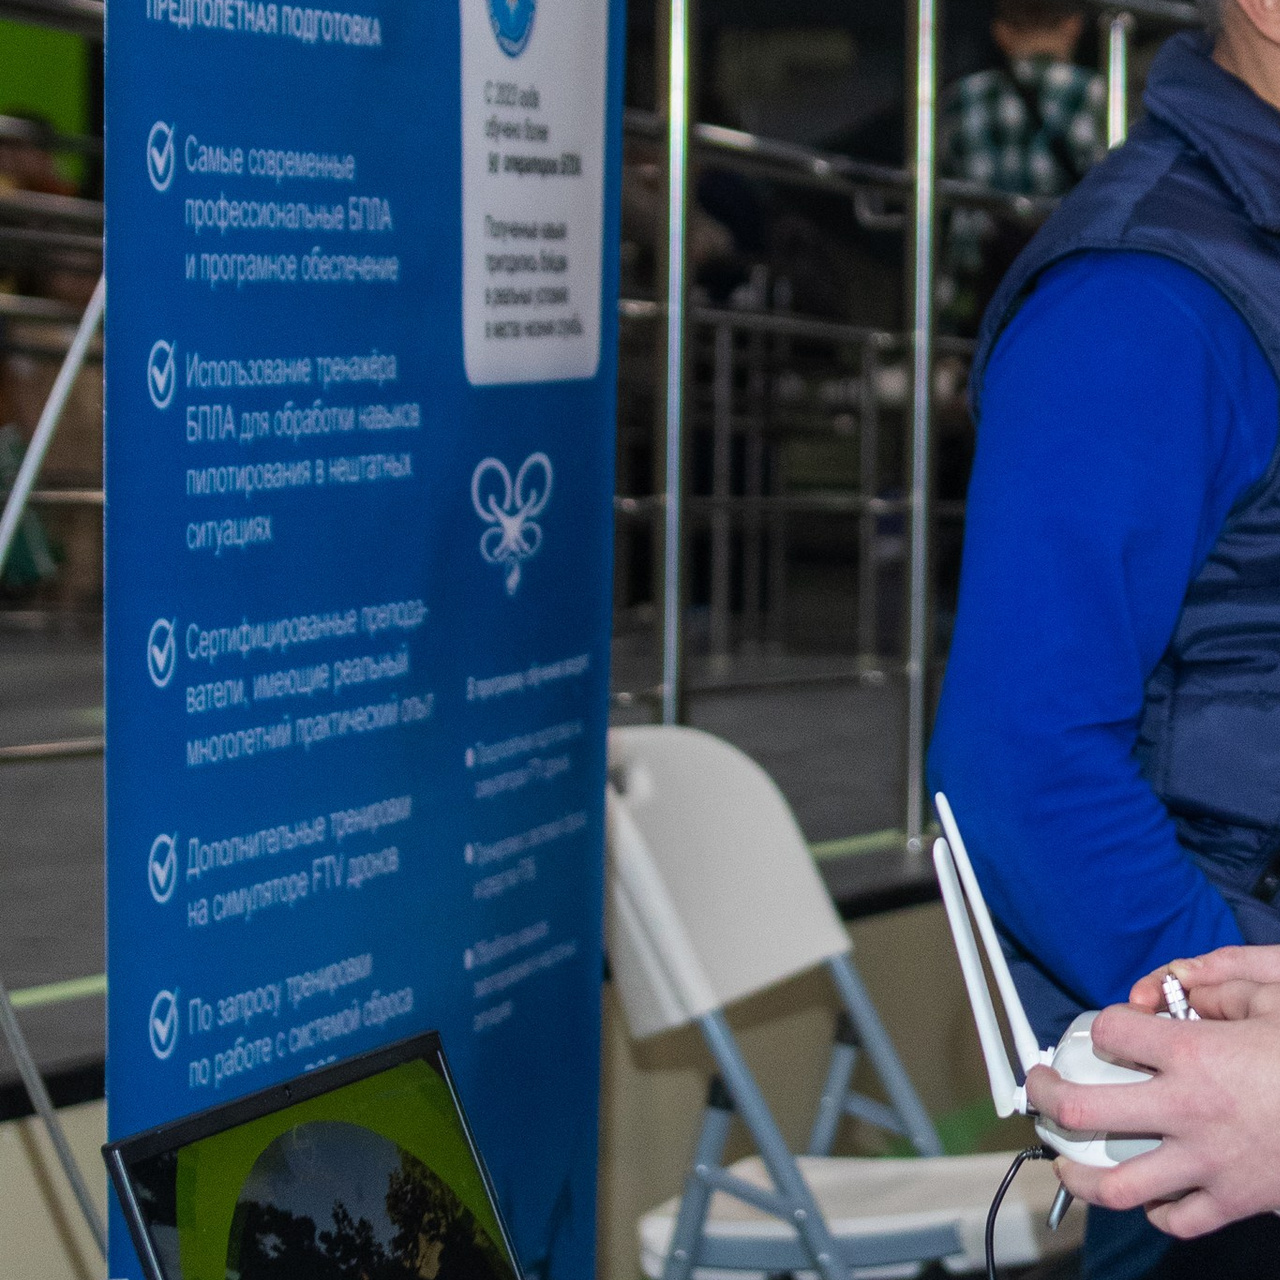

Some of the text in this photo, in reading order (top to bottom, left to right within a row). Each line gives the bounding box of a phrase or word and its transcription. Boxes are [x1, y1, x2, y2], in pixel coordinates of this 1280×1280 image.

[282, 5, 382, 47] ПОДГОТОВКА
[185, 134, 355, 186] Самые современные
[185, 190, 393, 236] профессиональные БПЛА
[185, 253, 195, 279] и
[301, 245, 399, 282] обеспечение
[186, 351, 311, 388] Использование
[186, 404, 236, 443] БПЛА
[239, 412, 269, 445] для
[186, 453, 412, 501] пилотирования в нештатных
[186, 515, 271, 557] ситуациях
[186, 609, 357, 665] Сертифицированные
[186, 642, 409, 714] ватели, имеющие реальный
[187, 714, 292, 767] многолетний
[186, 816, 326, 884] Дополнительные
[188, 898, 208, 927] на
[212, 871, 309, 922] симуляторе
[188, 997, 212, 1035] По
[217, 982, 282, 1025] запросу
[189, 1058, 210, 1087] по
[214, 1037, 272, 1088] работе
[276, 1032, 285, 1058] с
